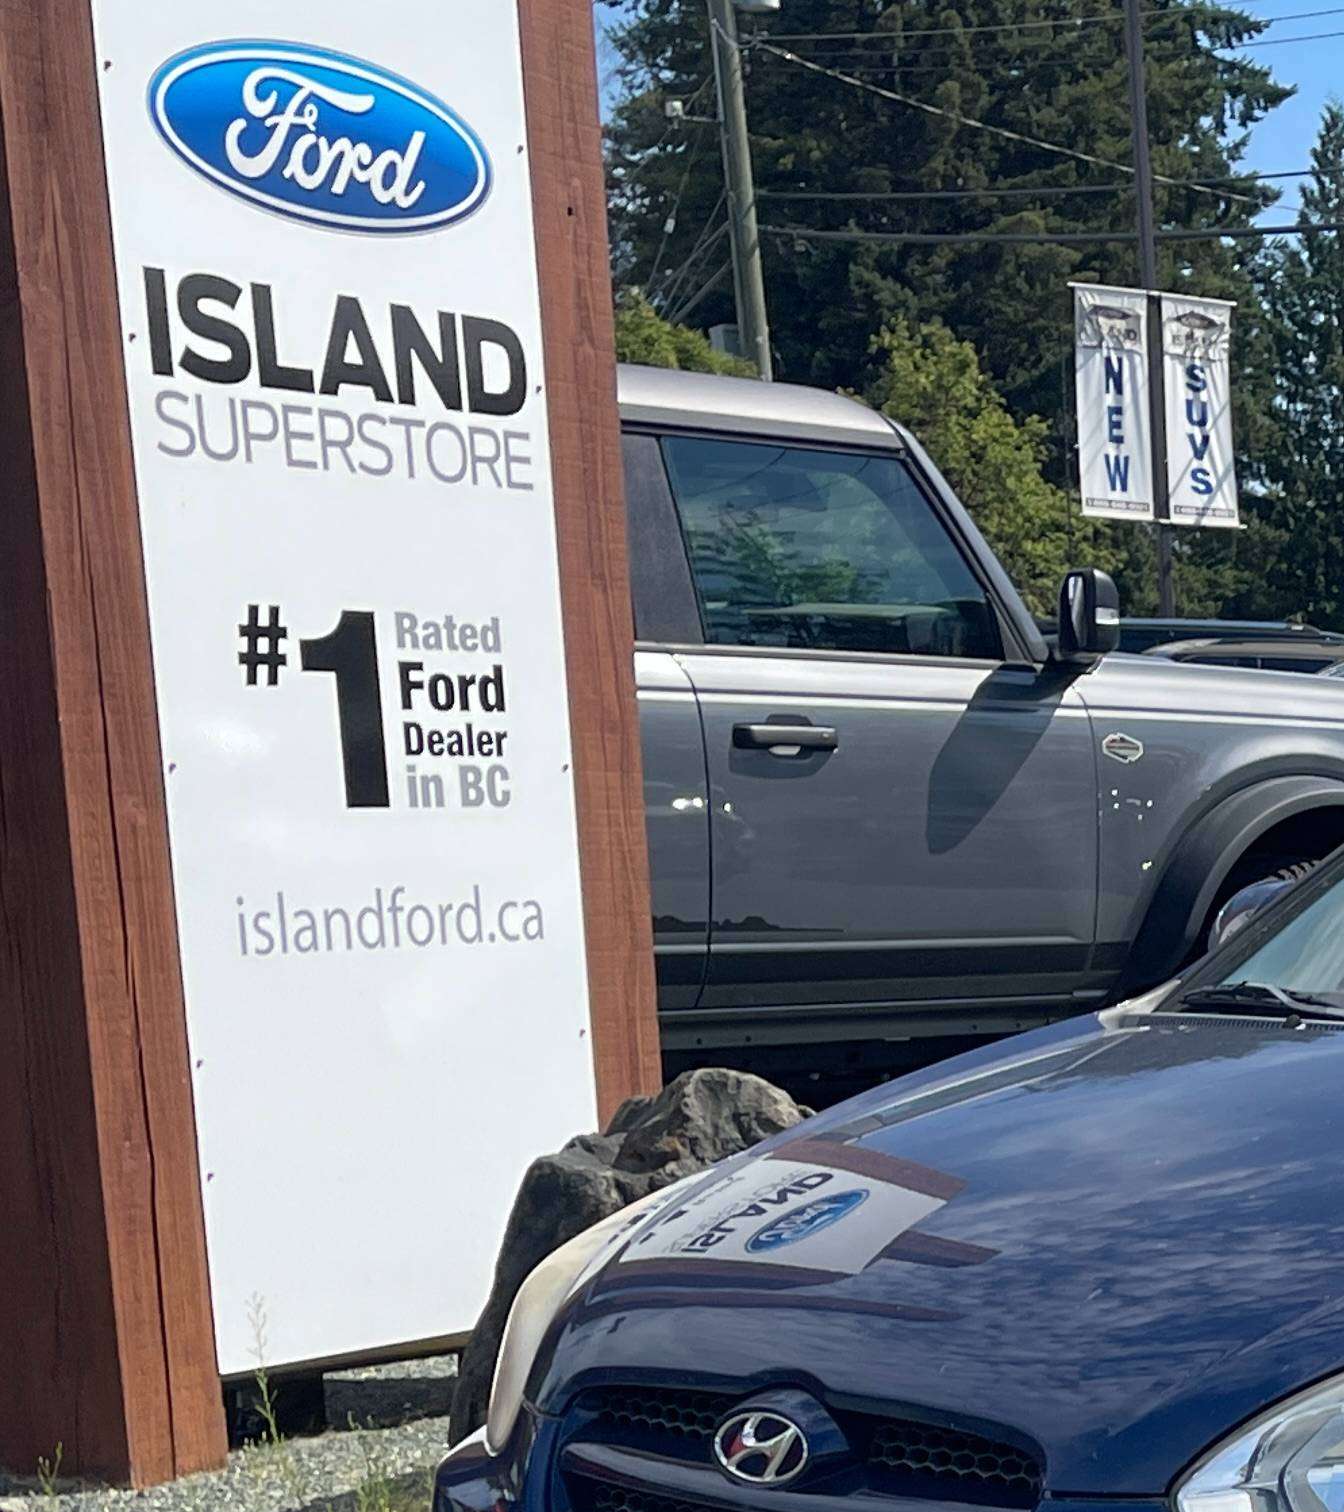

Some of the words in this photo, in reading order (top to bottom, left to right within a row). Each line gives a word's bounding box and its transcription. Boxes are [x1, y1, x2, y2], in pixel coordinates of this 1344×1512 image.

[225, 66, 427, 208] Ford
[142, 265, 527, 417] ISLAND
[155, 389, 534, 491] SUPERSTORE
[1104, 356, 1130, 493] NEW
[1185, 363, 1214, 496] SUVS
[394, 611, 502, 653] Rated
[397, 660, 507, 713] Ford
[402, 721, 509, 758] Dealer
[406, 765, 444, 808] in
[459, 764, 511, 808] BC
[236, 885, 544, 956] islandford.ca
